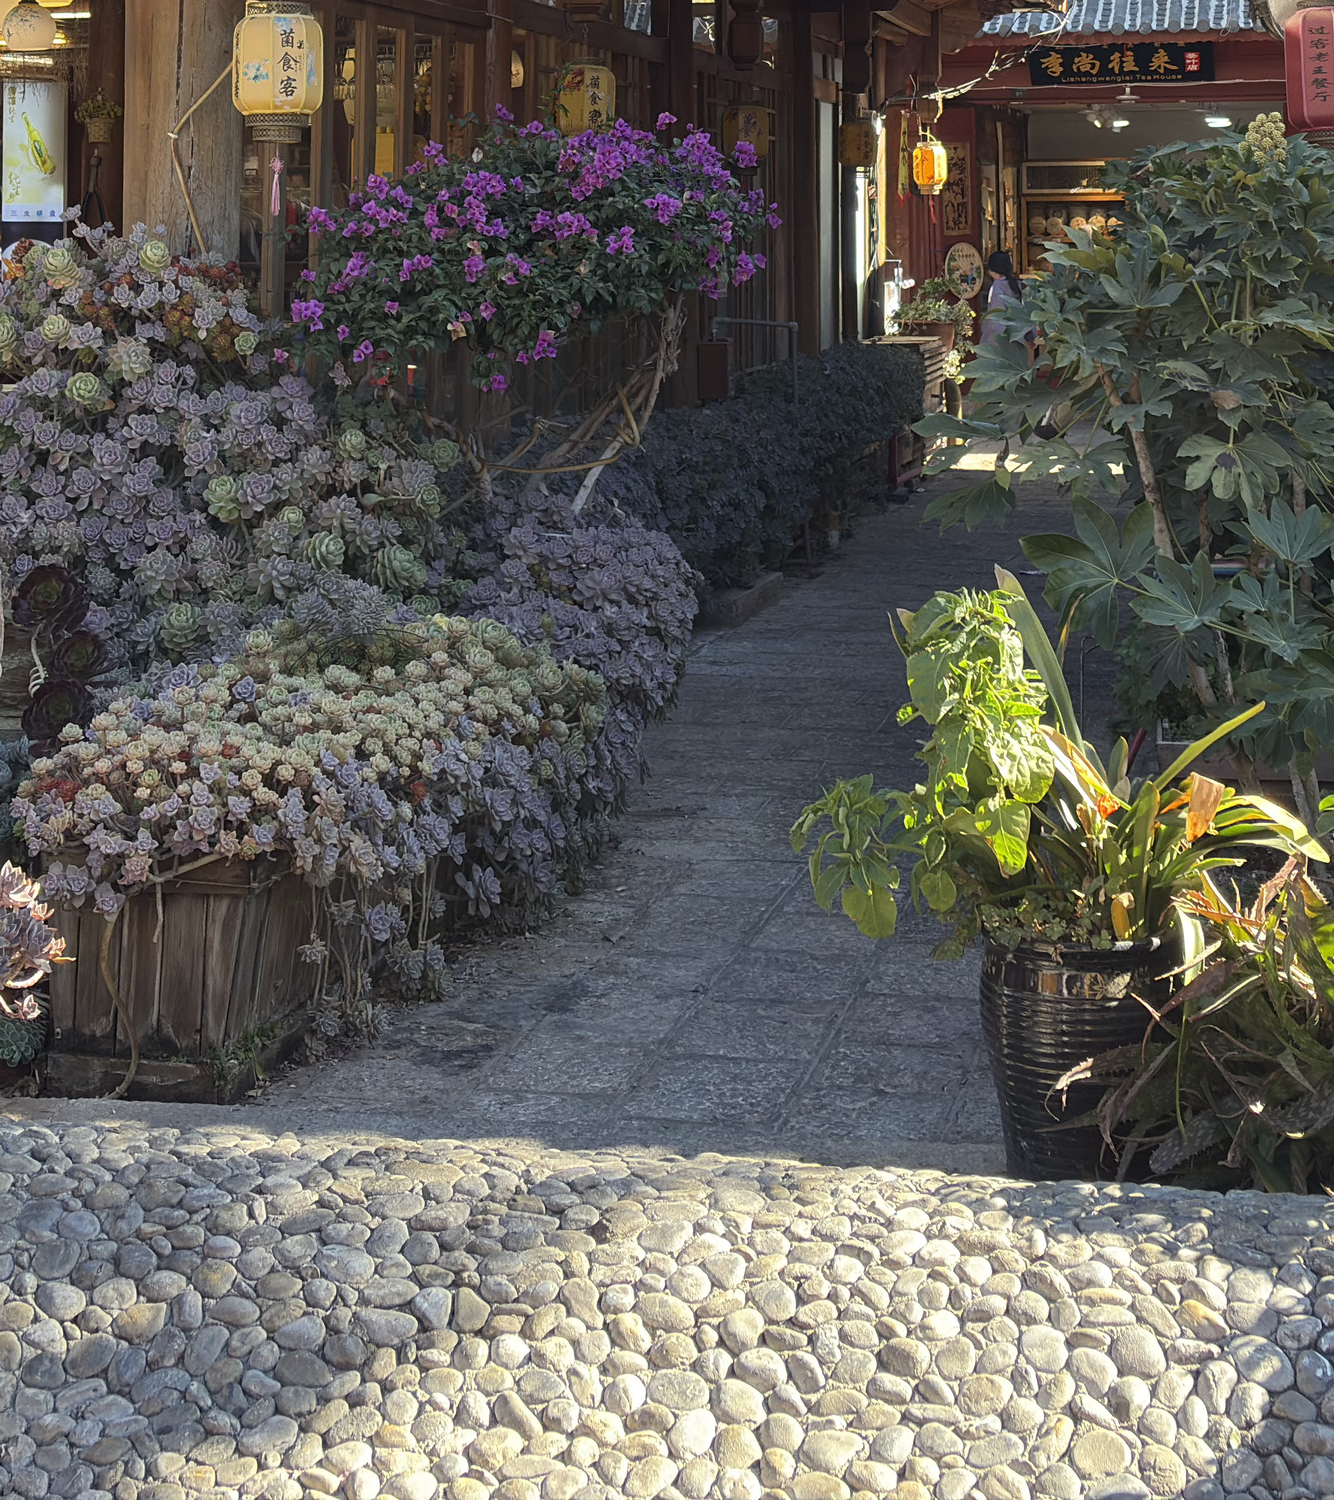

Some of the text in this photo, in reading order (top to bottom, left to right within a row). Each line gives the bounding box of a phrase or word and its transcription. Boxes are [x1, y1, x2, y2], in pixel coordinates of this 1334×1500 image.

[276, 27, 300, 98] 菌食客
[1039, 49, 1180, 77] 李尚往来
[1308, 26, 1334, 102] 过客老王餐厅
[588, 76, 602, 124] 菌食客
